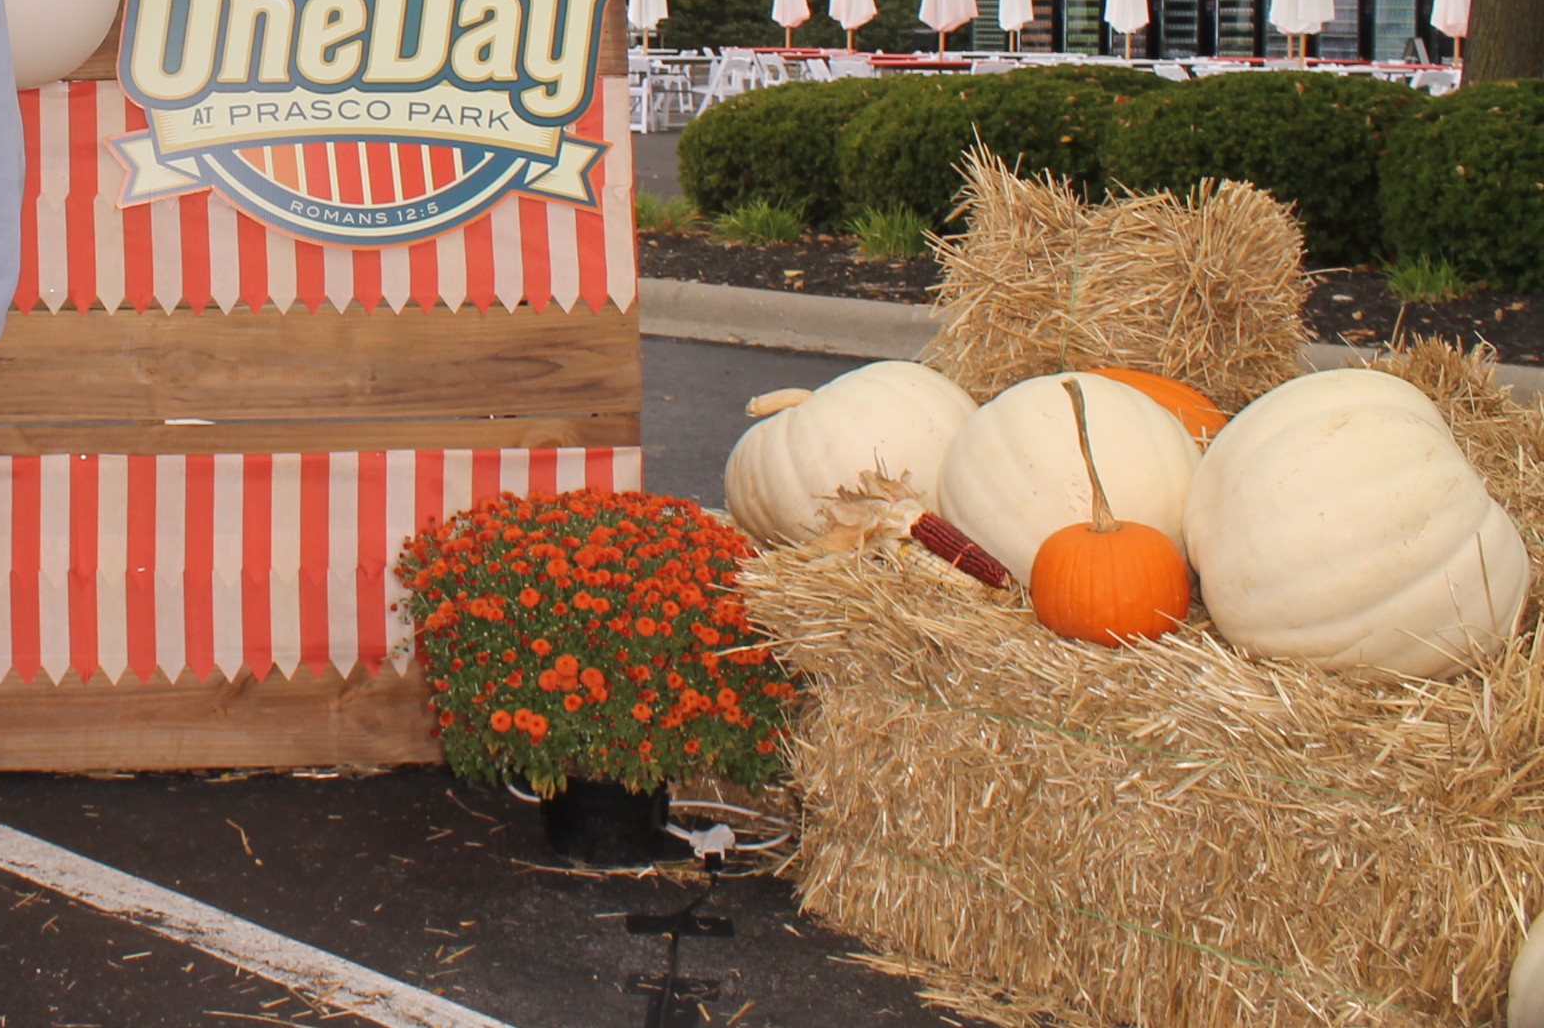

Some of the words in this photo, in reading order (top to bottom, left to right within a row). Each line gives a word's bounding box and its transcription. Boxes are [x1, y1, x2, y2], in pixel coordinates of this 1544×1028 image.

[191, 106, 214, 126] AT
[228, 99, 392, 126] PRASCO
[407, 101, 511, 132] PARK
[289, 200, 388, 225] ROMANS
[396, 201, 440, 222] 12:5
